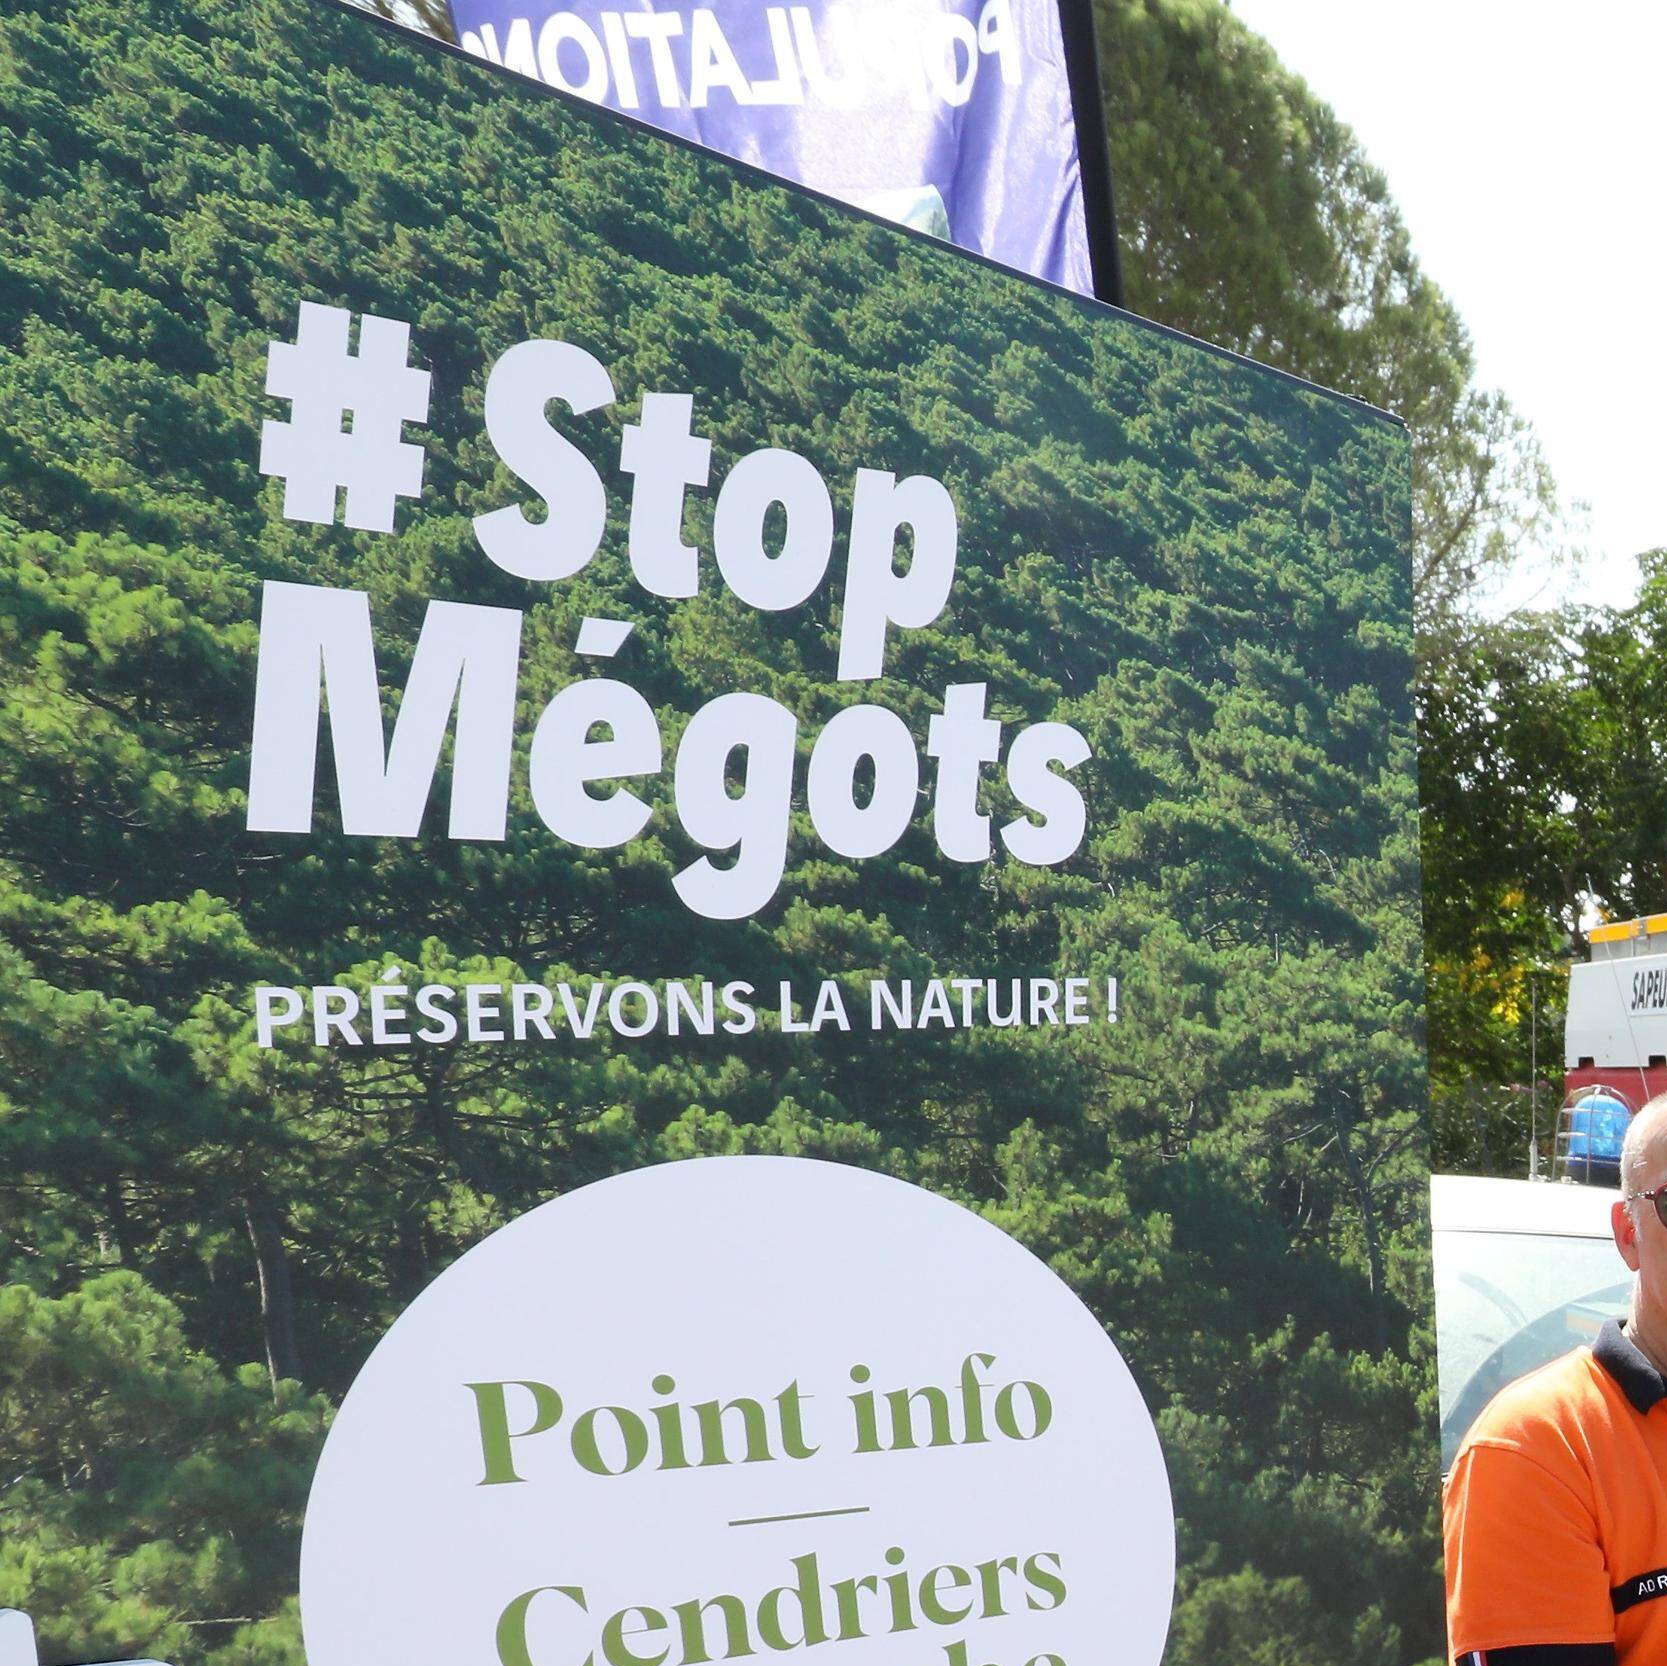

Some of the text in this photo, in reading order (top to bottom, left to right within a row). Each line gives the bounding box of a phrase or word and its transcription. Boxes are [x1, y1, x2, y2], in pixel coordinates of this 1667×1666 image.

[259, 300, 958, 680] #Stop
[246, 579, 1093, 920] Mégots
[254, 965, 757, 1050] PRÉSERVONS
[779, 979, 850, 1032] LA
[464, 1351, 1053, 1487] Point info
